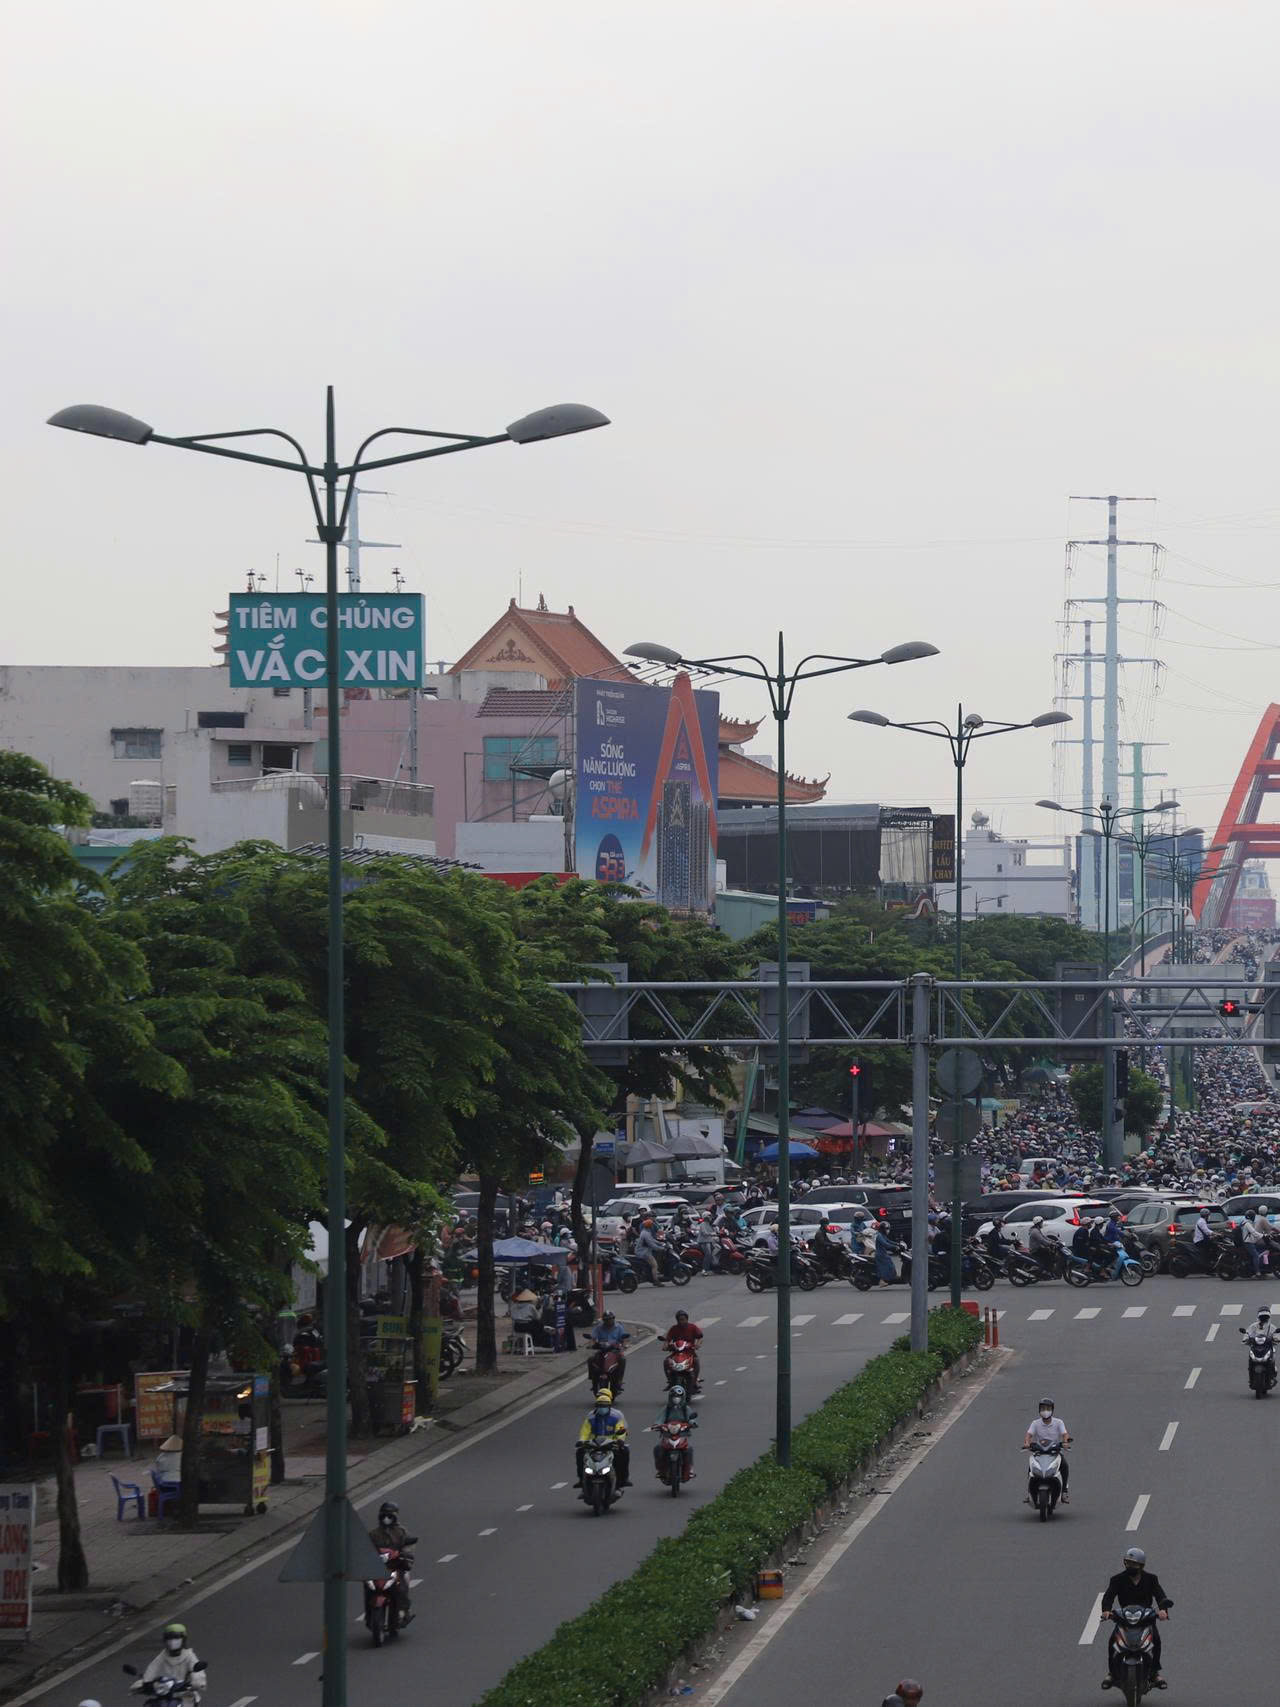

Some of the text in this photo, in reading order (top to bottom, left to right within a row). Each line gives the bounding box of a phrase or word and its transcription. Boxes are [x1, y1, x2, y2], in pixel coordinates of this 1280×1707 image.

[236, 599, 416, 629] TIÊM CHỦNG
[236, 633, 416, 681] VẮC XIN
[600, 736, 624, 759] SỐNG
[583, 756, 636, 780] NĂNG LƯỢNG
[589, 780, 606, 792] CHỌN
[592, 795, 640, 820] ASPIRA
